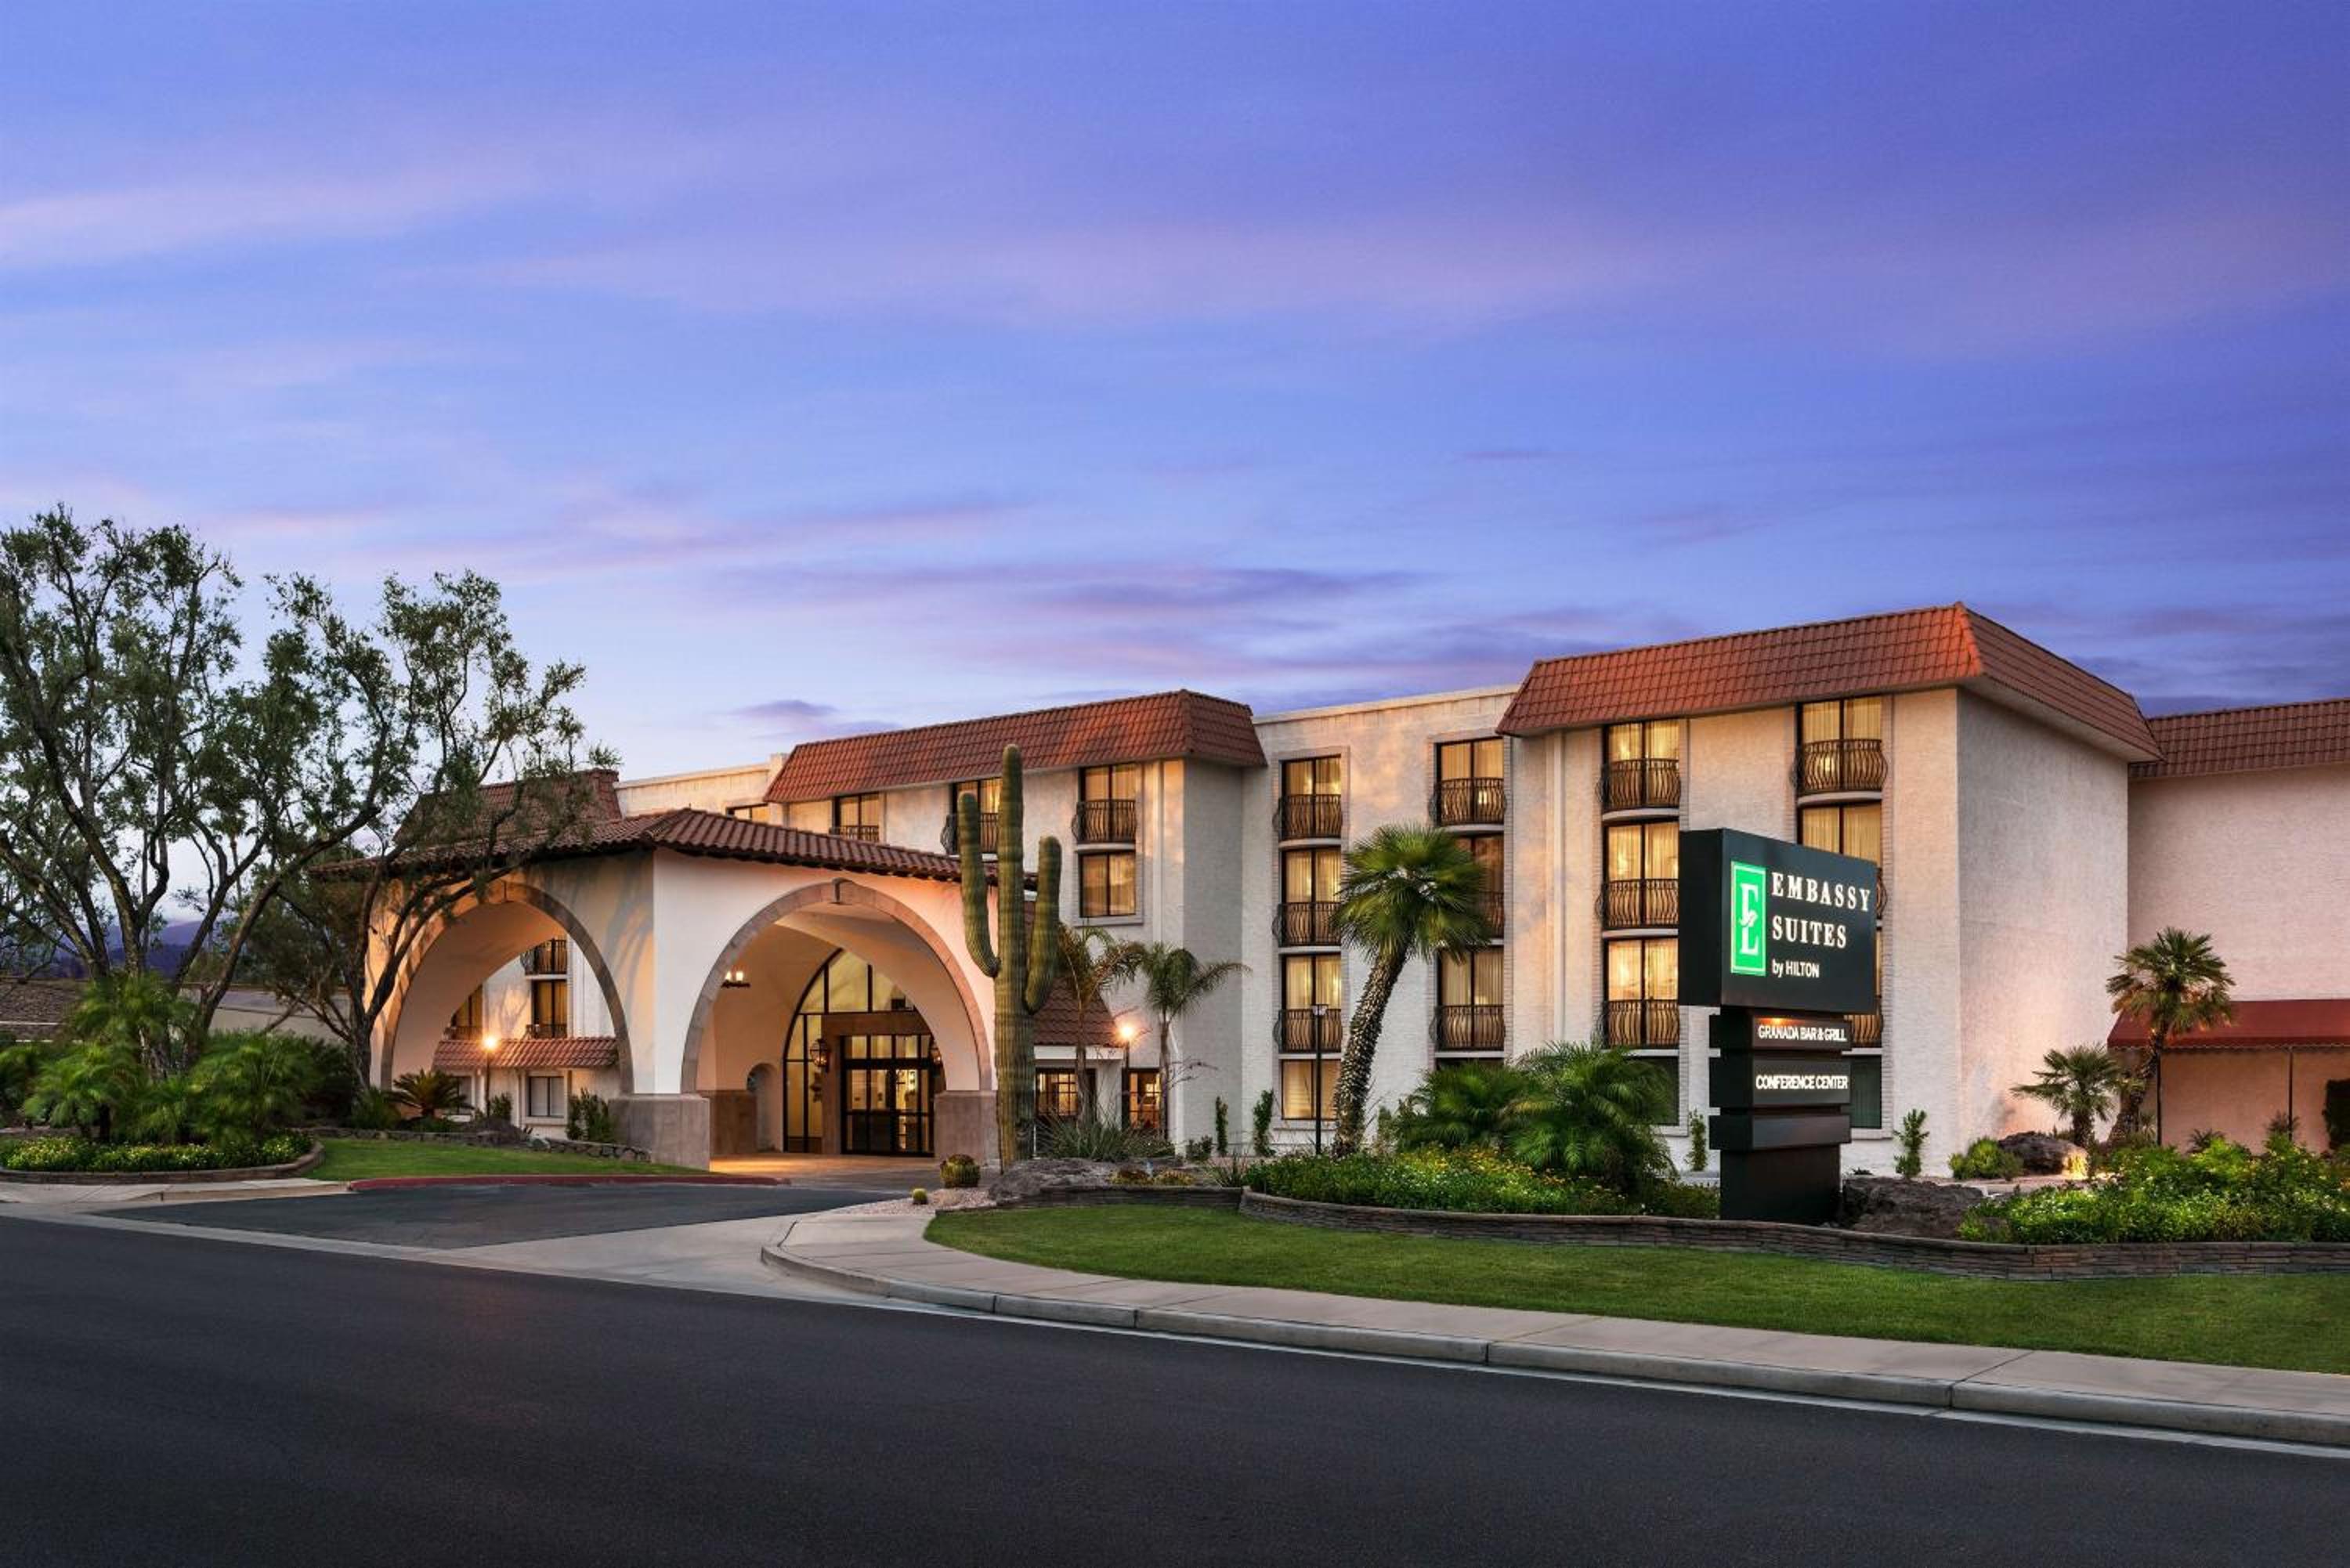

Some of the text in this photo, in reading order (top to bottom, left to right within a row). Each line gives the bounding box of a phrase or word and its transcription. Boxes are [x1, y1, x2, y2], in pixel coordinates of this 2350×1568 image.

[1771, 872, 1871, 912] EMBASSY
[1772, 915, 1847, 948] SUITES
[1772, 959, 1820, 978] by HILTON
[1758, 1024, 1848, 1042] GRANADA BAR & GRILL
[1755, 1075, 1849, 1089] CONFERENCE CENTER
